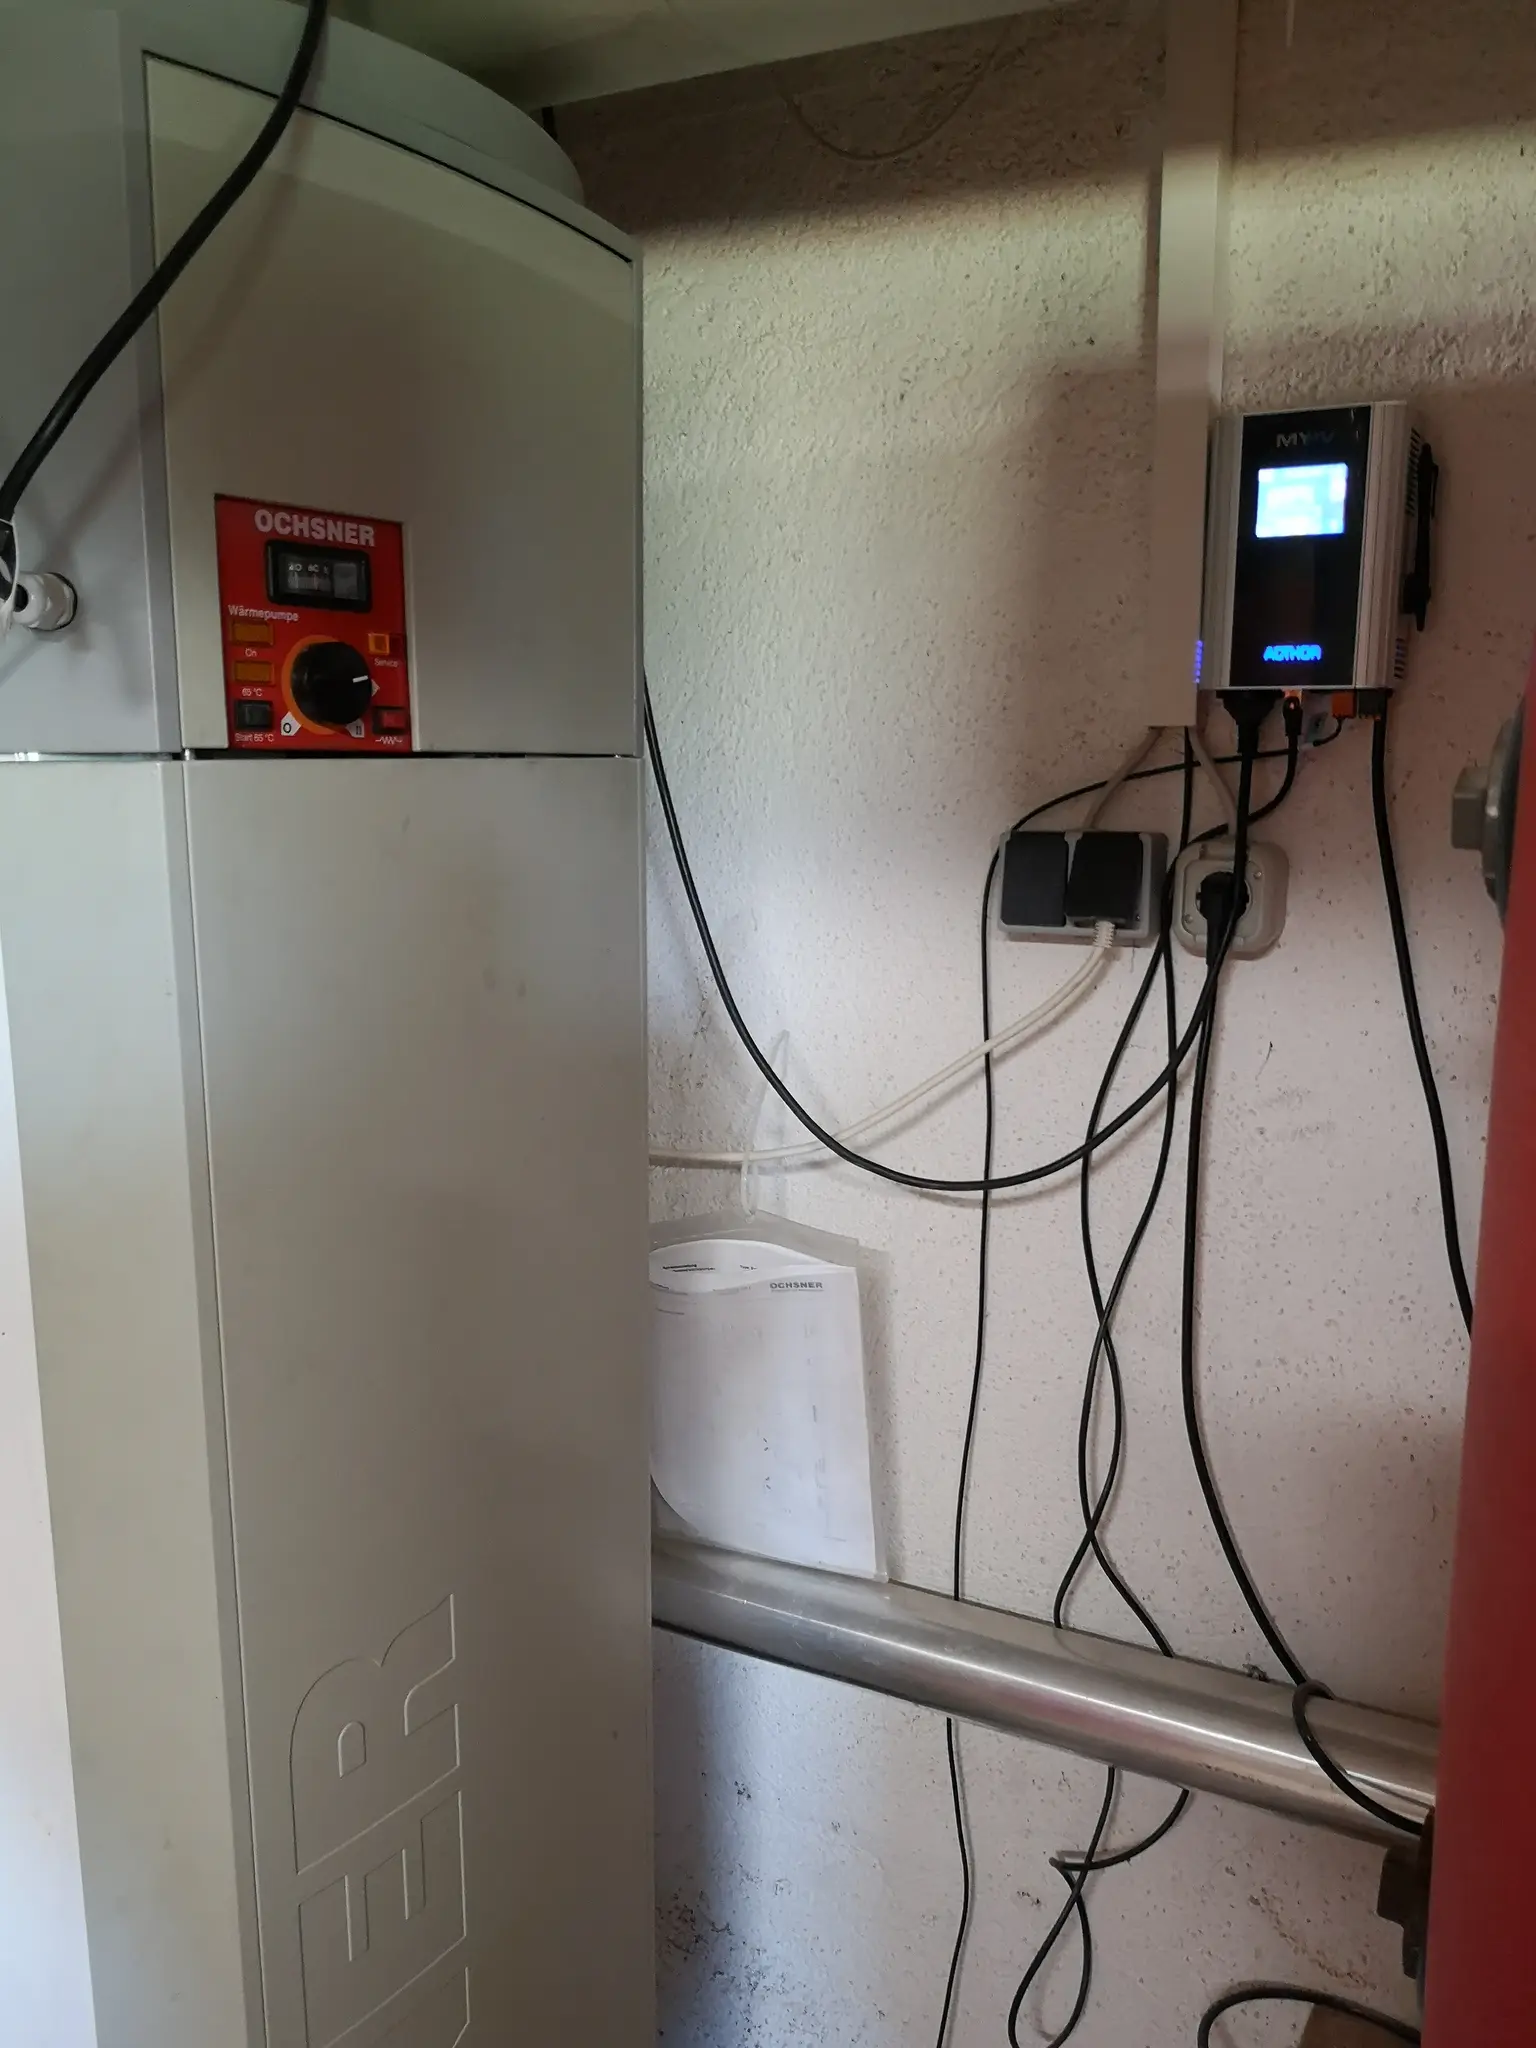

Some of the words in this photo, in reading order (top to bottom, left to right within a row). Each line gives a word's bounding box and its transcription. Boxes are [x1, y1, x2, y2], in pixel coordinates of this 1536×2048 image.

[254, 508, 376, 548] OCHSNER
[227, 604, 299, 623] Wärmepumpe
[245, 647, 257, 657] On
[769, 1281, 824, 1290] OCHSNER
